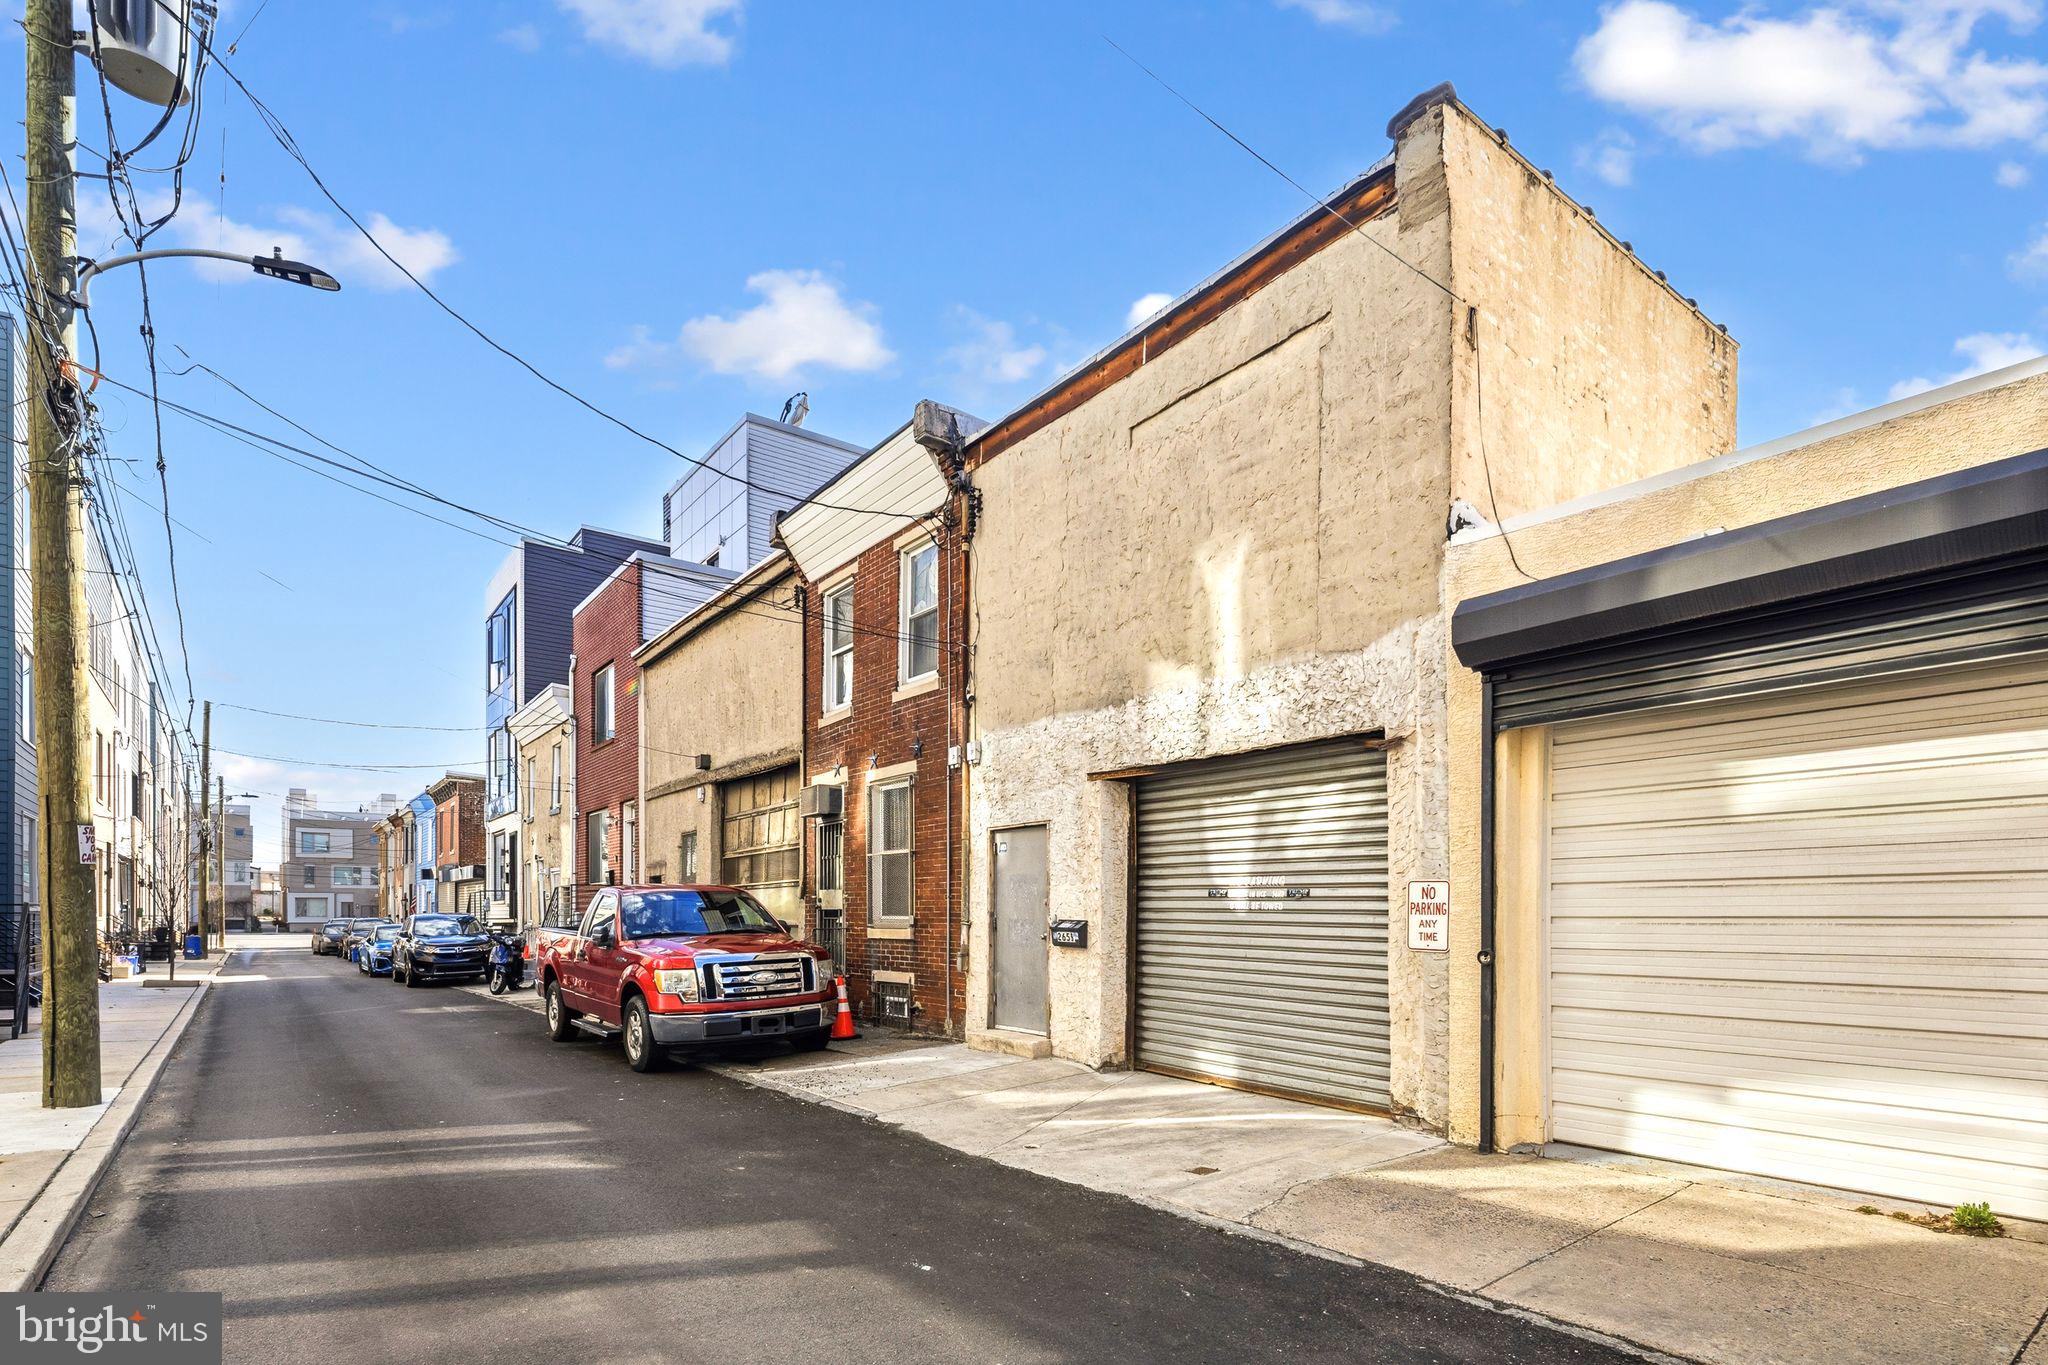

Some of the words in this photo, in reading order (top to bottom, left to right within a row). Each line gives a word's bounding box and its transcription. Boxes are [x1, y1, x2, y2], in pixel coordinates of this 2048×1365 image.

[1421, 886, 1436, 900] NO
[1410, 902, 1447, 915] PARKING
[1419, 919, 1438, 928] ANY
[1419, 931, 1438, 942] TIME
